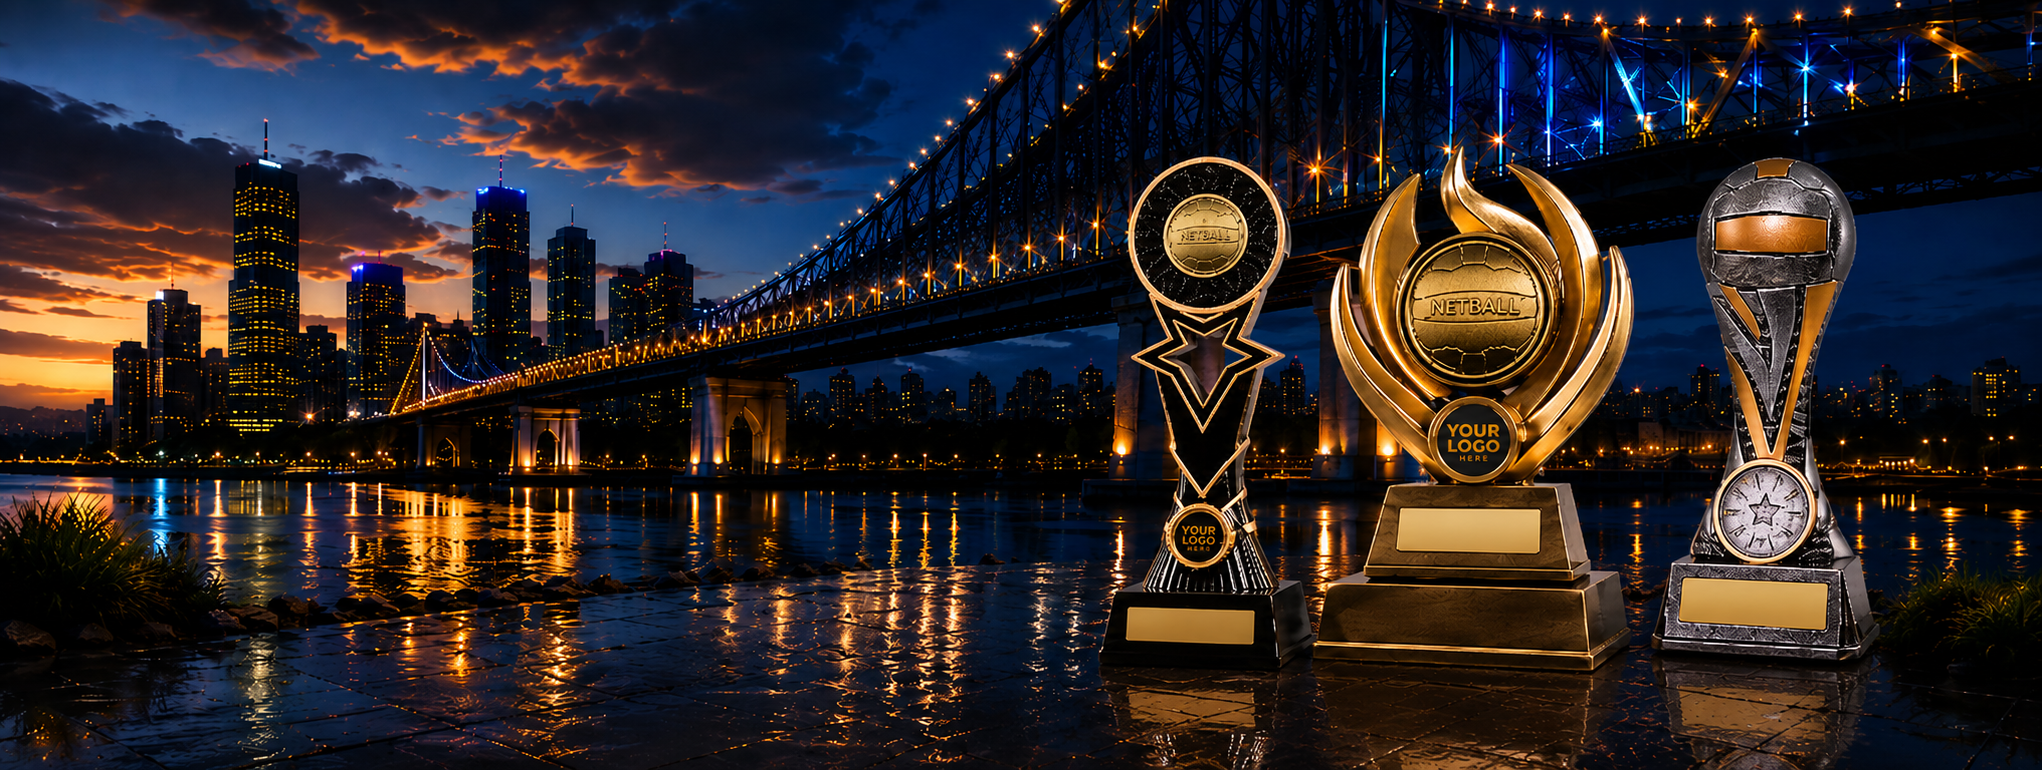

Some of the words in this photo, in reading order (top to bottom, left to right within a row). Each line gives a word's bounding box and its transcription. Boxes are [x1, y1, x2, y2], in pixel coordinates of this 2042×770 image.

[1431, 297, 1520, 315] NETBALL
[1446, 423, 1500, 438] YOUR
[1447, 439, 1500, 453] LOGO
[1459, 454, 1488, 462] HERE
[1181, 525, 1216, 535] YOUR
[1182, 536, 1216, 545] LOGO
